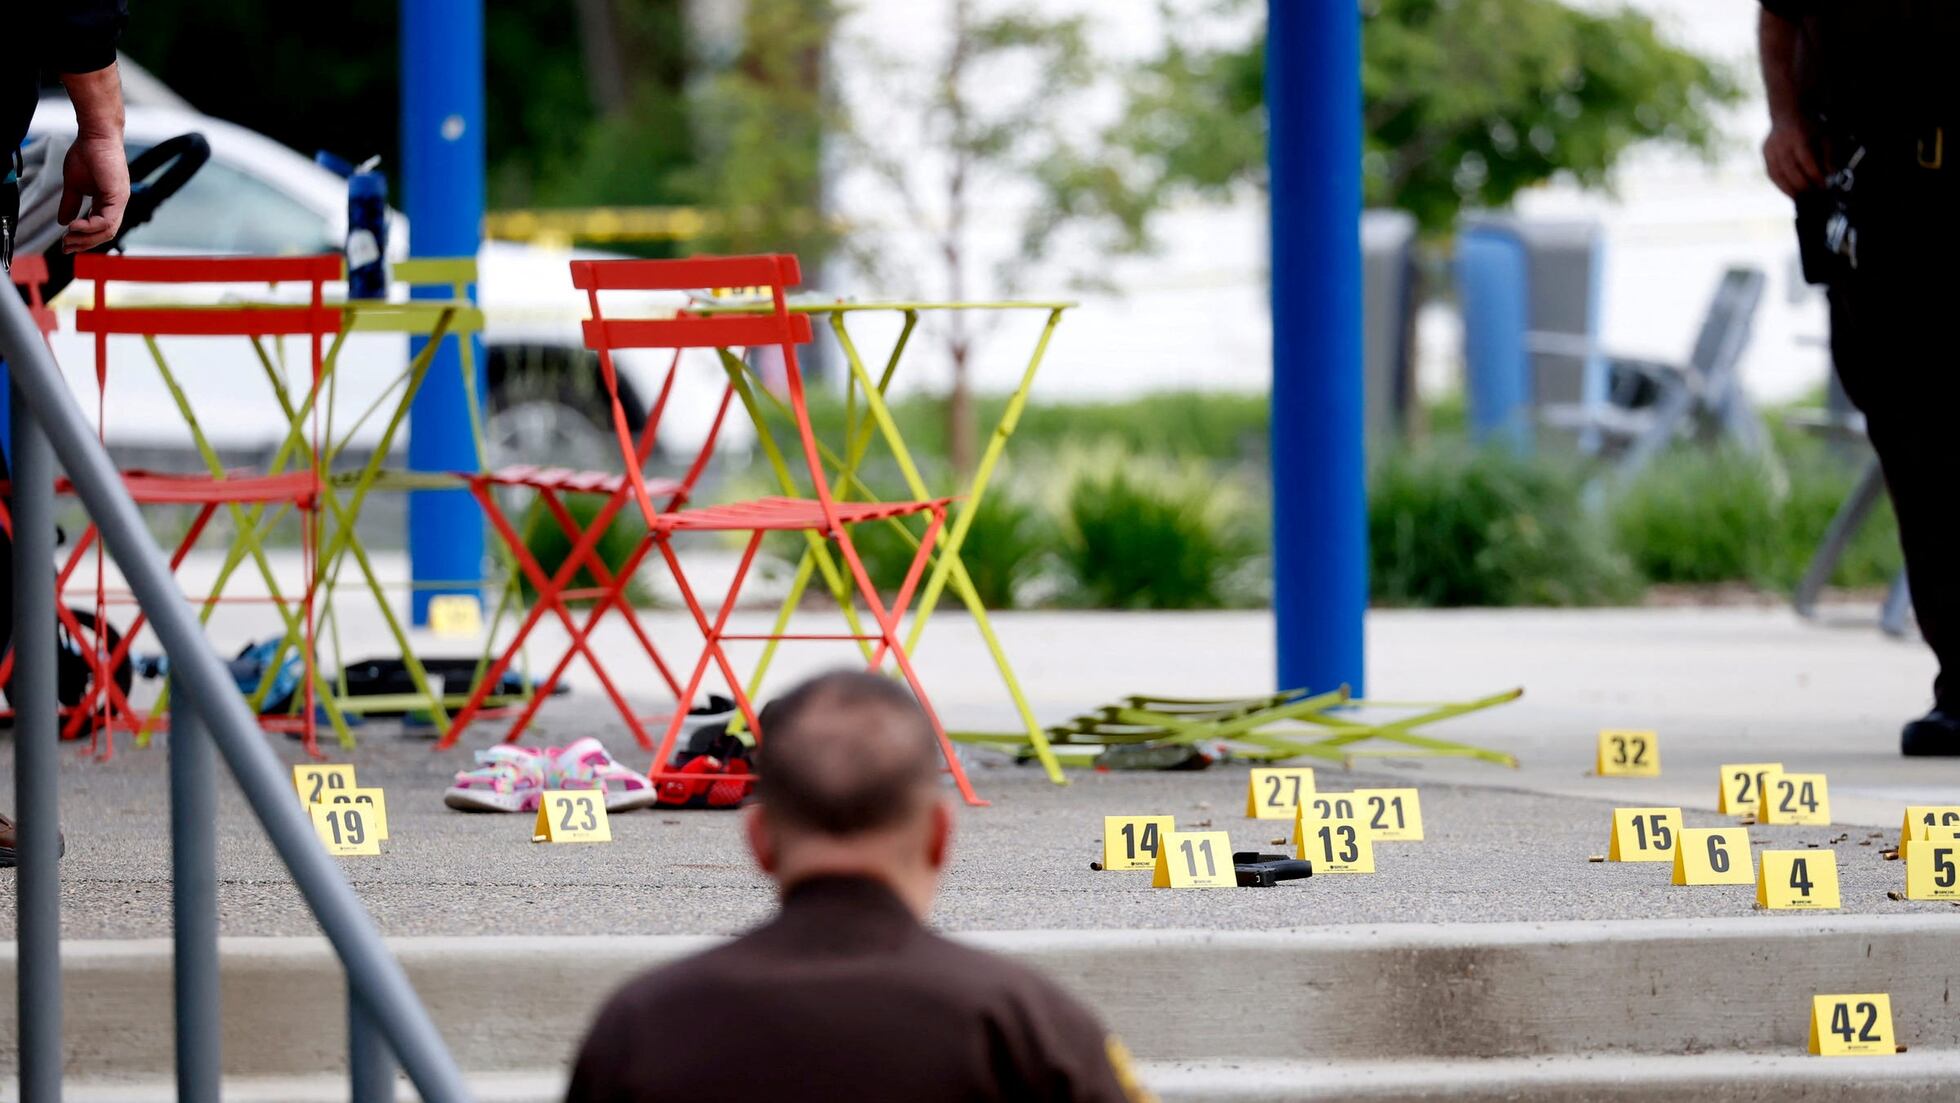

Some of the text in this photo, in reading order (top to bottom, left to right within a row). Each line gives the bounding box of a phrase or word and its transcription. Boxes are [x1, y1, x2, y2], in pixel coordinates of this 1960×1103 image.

[1611, 736, 1648, 767] 32
[1265, 775, 1301, 807] 27
[1777, 781, 1819, 813] 24
[326, 810, 365, 845] 19
[556, 797, 597, 831] 23
[1368, 796, 1405, 830] 21
[1121, 823, 1159, 859] 14
[1318, 825, 1359, 863] 13
[1632, 814, 1672, 850] 15
[1180, 839, 1216, 877] 11
[1706, 834, 1730, 873] 6
[1934, 848, 1956, 888] 5
[1789, 858, 1814, 897] 4
[1831, 1002, 1881, 1042] 42
